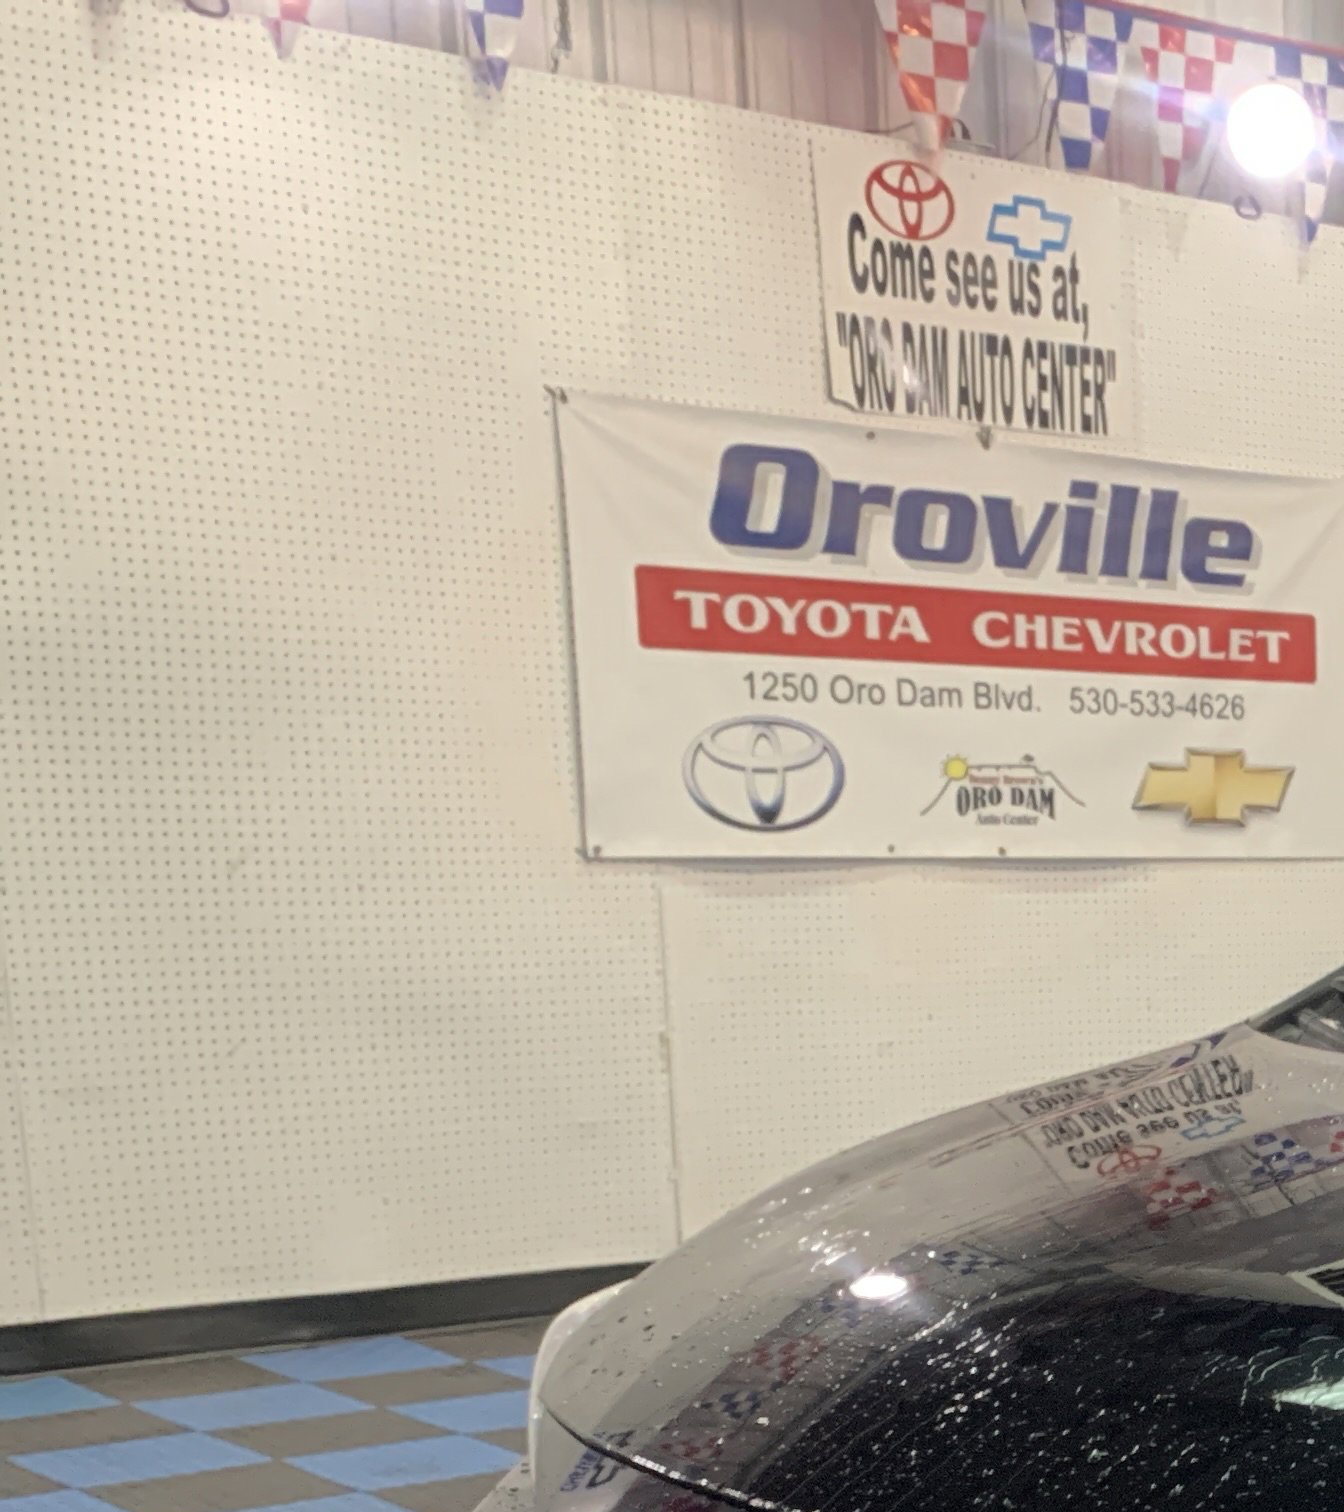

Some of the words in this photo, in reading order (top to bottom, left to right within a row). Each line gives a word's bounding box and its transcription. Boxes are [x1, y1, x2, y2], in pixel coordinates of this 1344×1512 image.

[848, 213, 936, 303] Come
[946, 249, 998, 311] see
[1008, 259, 1042, 318] us
[1053, 251, 1090, 343] at,
[902, 321, 950, 418] DAM
[958, 329, 1014, 426] AUTO
[1022, 337, 1117, 436] CENTER"
[709, 443, 1257, 588] Oroville
[673, 590, 930, 643] TOYOTA
[972, 609, 1290, 664] CHEVROLET
[742, 671, 818, 704] 1250
[830, 674, 886, 706] Oro
[896, 678, 964, 709] Dam
[975, 681, 1042, 713] Blvd.
[1069, 686, 1246, 721] 530-533-4626
[956, 785, 1003, 817] ORO
[1010, 786, 1057, 821] DAM
